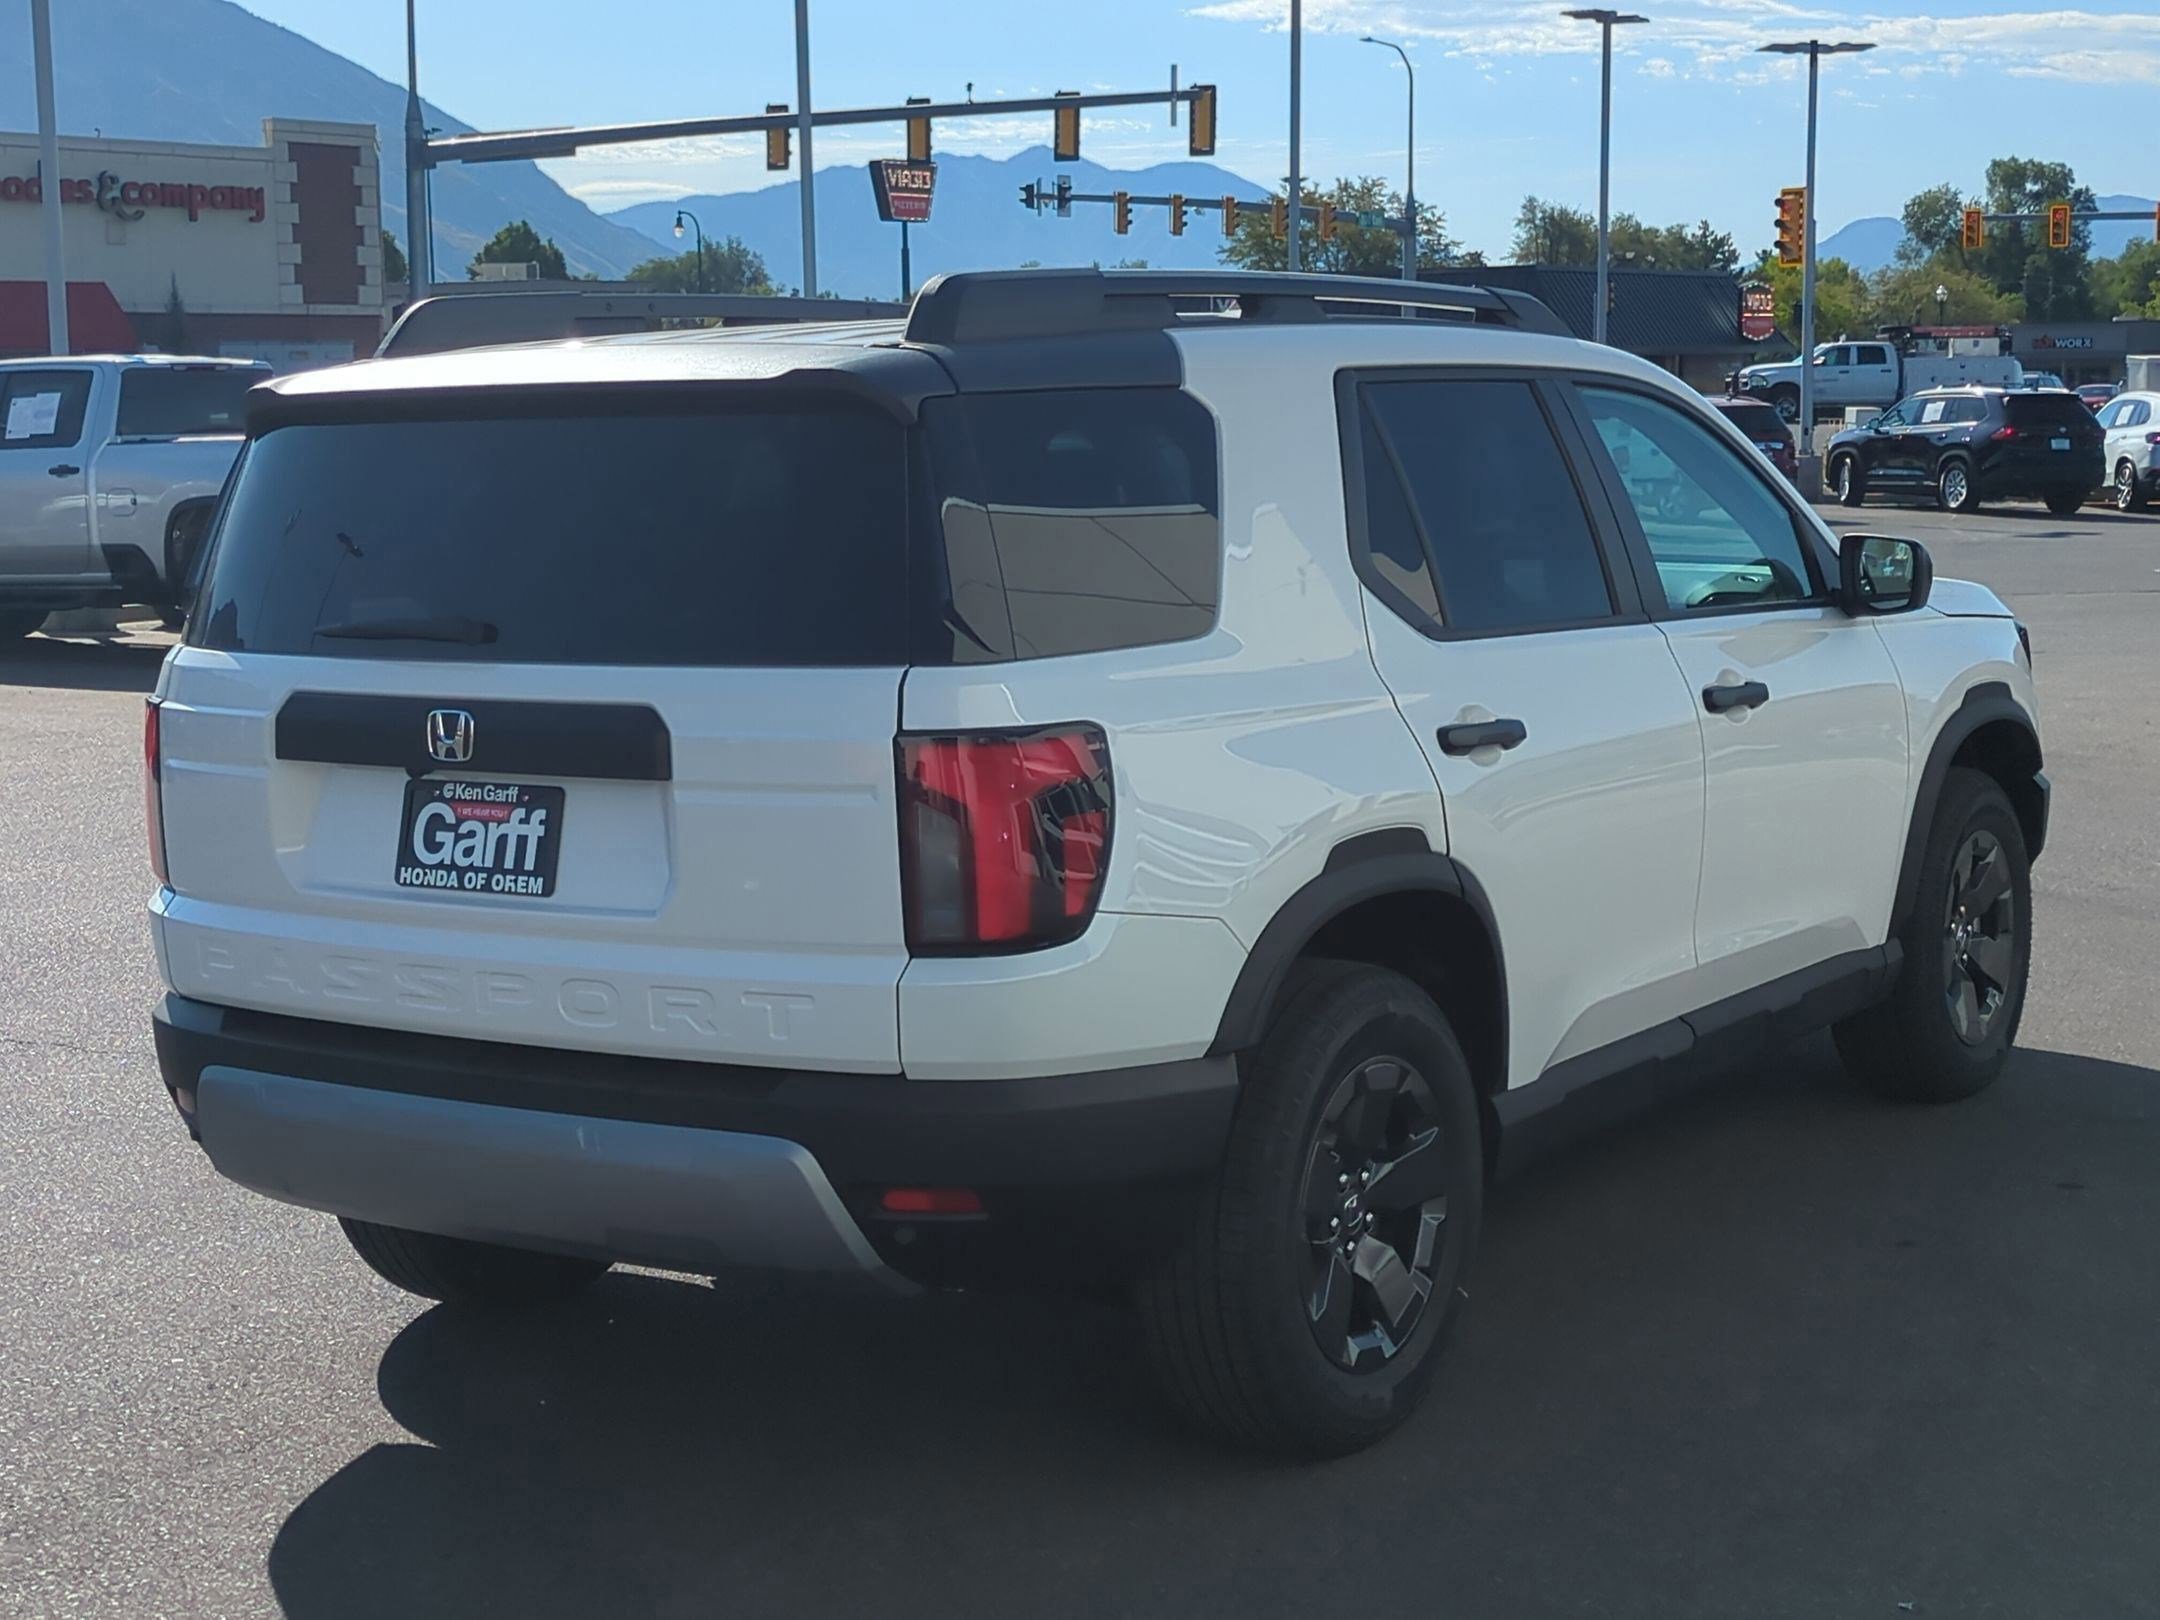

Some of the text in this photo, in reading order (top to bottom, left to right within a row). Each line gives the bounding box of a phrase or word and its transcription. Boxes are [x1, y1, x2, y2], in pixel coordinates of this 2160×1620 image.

[120, 181, 265, 222] company
[455, 783, 519, 803] Ken Garff
[413, 802, 546, 871] Garff
[400, 867, 543, 895] HONDA OF OREM
[195, 937, 815, 1040] PASSPORT
